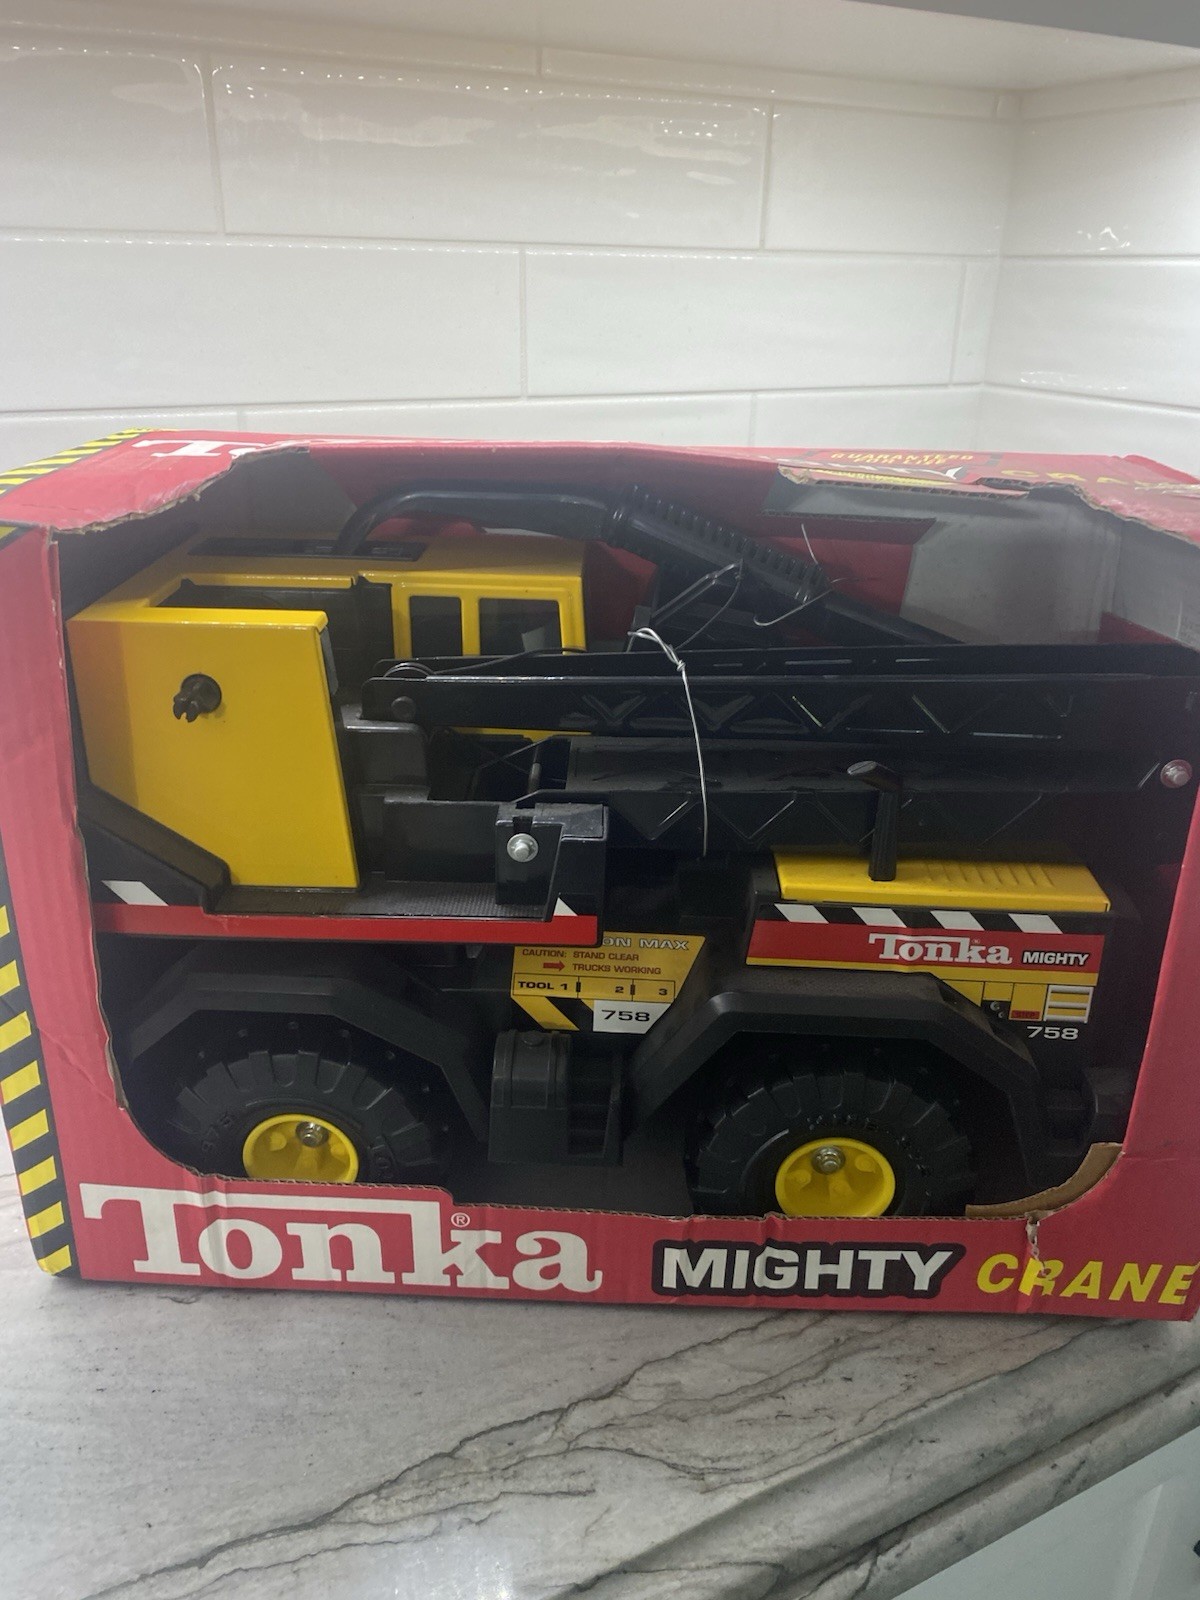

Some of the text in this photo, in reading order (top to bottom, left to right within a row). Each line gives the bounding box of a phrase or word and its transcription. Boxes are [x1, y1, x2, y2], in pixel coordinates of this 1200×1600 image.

[639, 939, 689, 951] MAX
[868, 932, 1012, 965] Tonka
[1022, 950, 1090, 966] MIGHTY
[522, 948, 640, 962] CAUTION: STAND CLEAR
[572, 963, 662, 975] TRUCKS WORKING
[518, 980, 668, 996] TOOL 1 2 3
[601, 1009, 650, 1022] 758
[1026, 1026, 1079, 1040] 758
[79, 1182, 603, 1293] Tonka
[661, 1246, 954, 1292] MIGHTY
[976, 1252, 1200, 1305] CRANE
